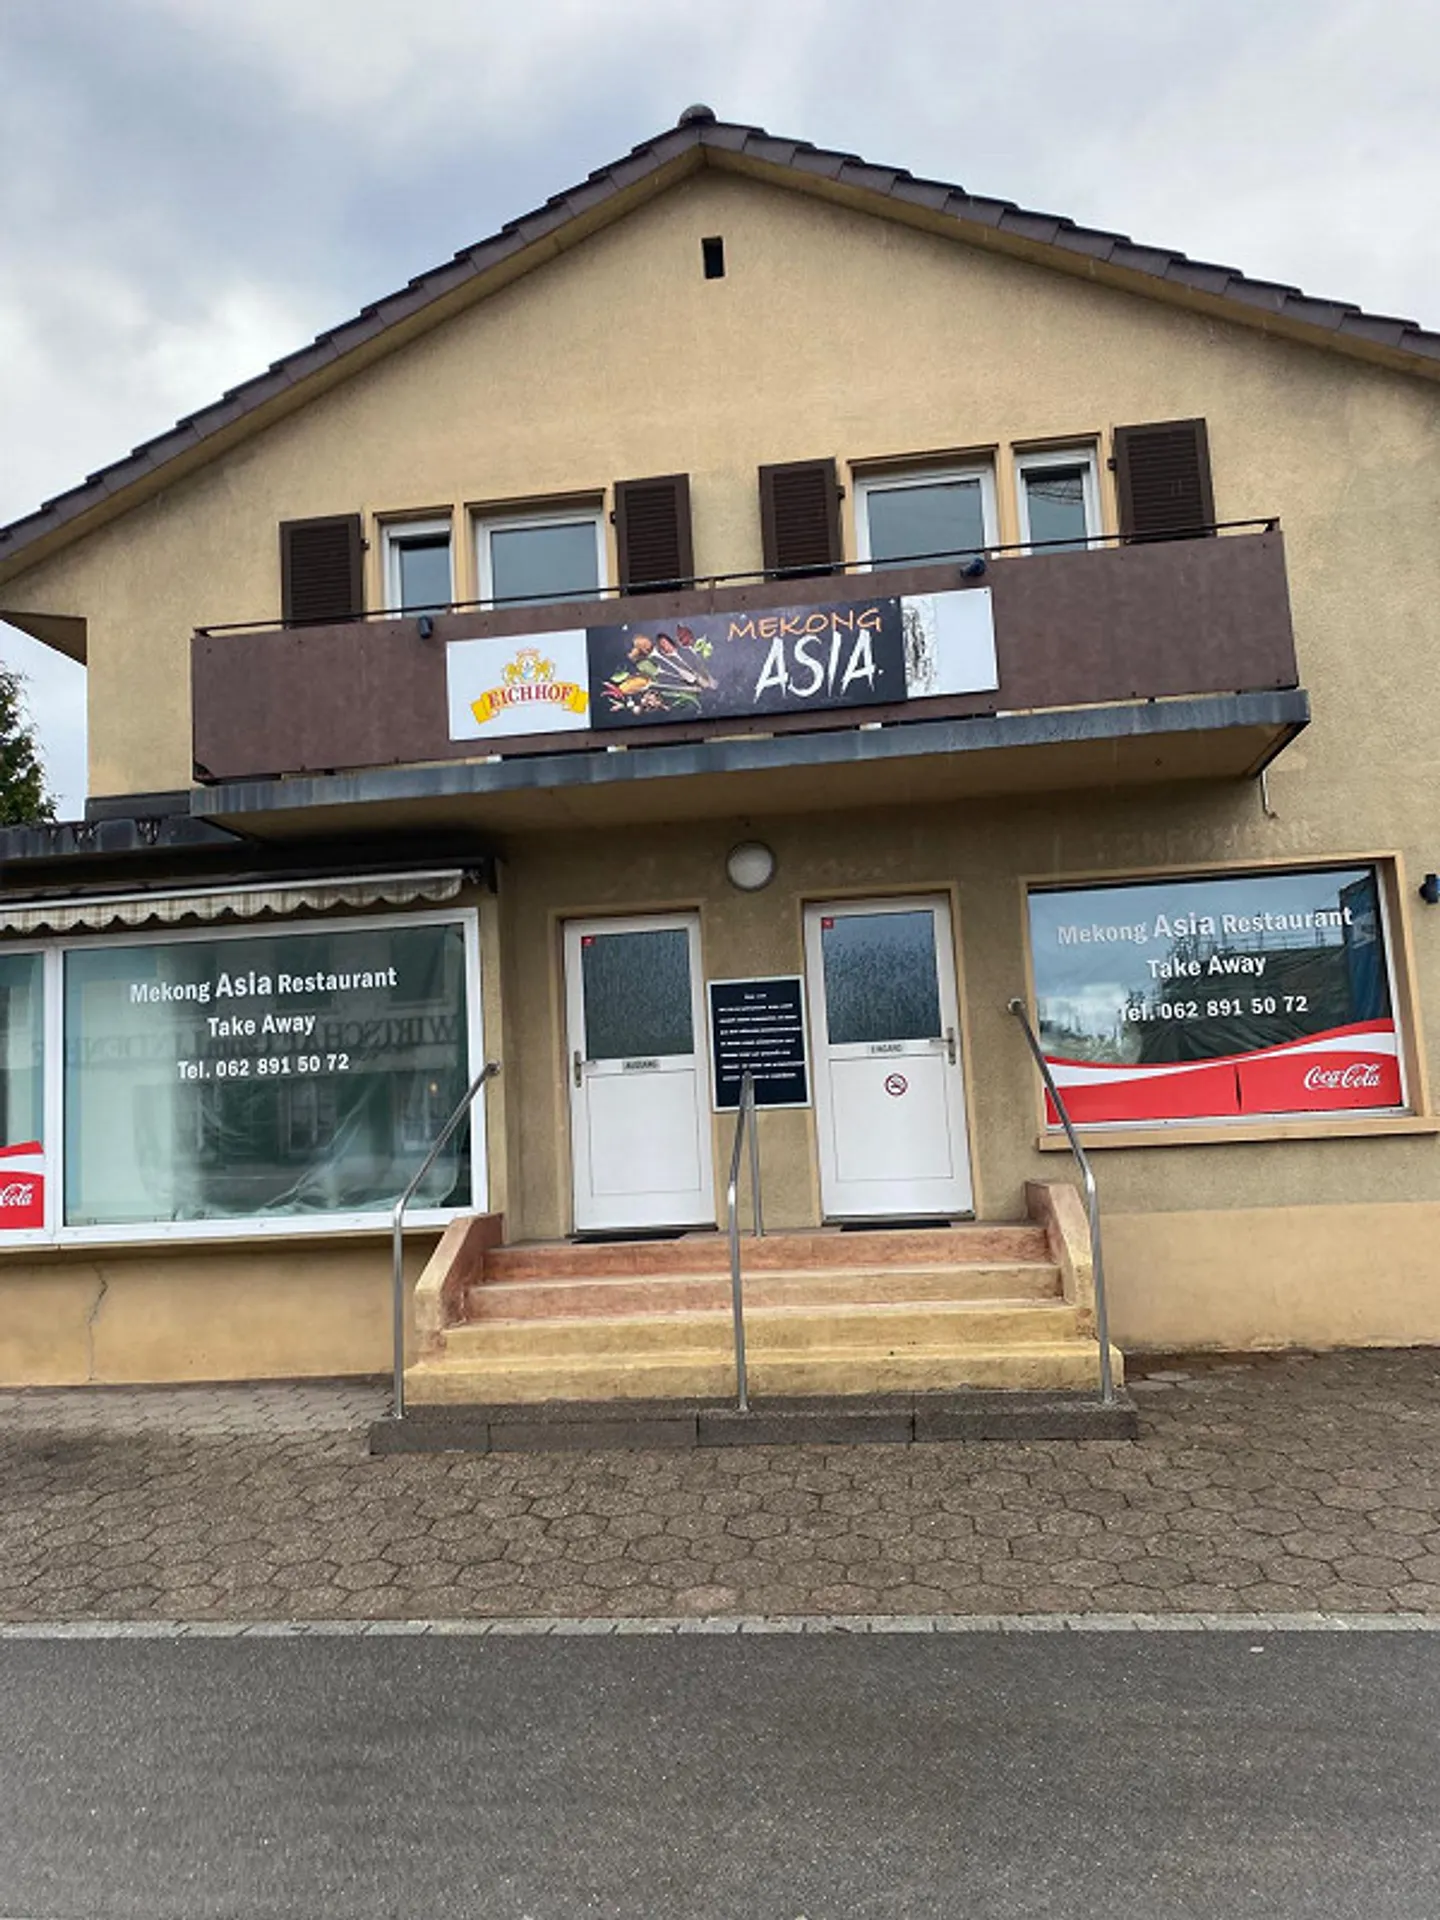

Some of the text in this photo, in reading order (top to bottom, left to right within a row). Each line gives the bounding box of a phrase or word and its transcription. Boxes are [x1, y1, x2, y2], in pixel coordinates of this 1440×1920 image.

[727, 607, 883, 643] MEKONG
[487, 683, 574, 709] EICHHOF
[1057, 906, 1353, 945] Mekong Asia Restaurant
[1146, 955, 1267, 980] Take Away
[130, 966, 397, 1003] Mekong Asia Restaurant
[1121, 995, 1308, 1022] Tel. 062 891 50 72
[207, 1013, 316, 1037] Take Away
[177, 1053, 350, 1080] Tel. 062 891 50 72
